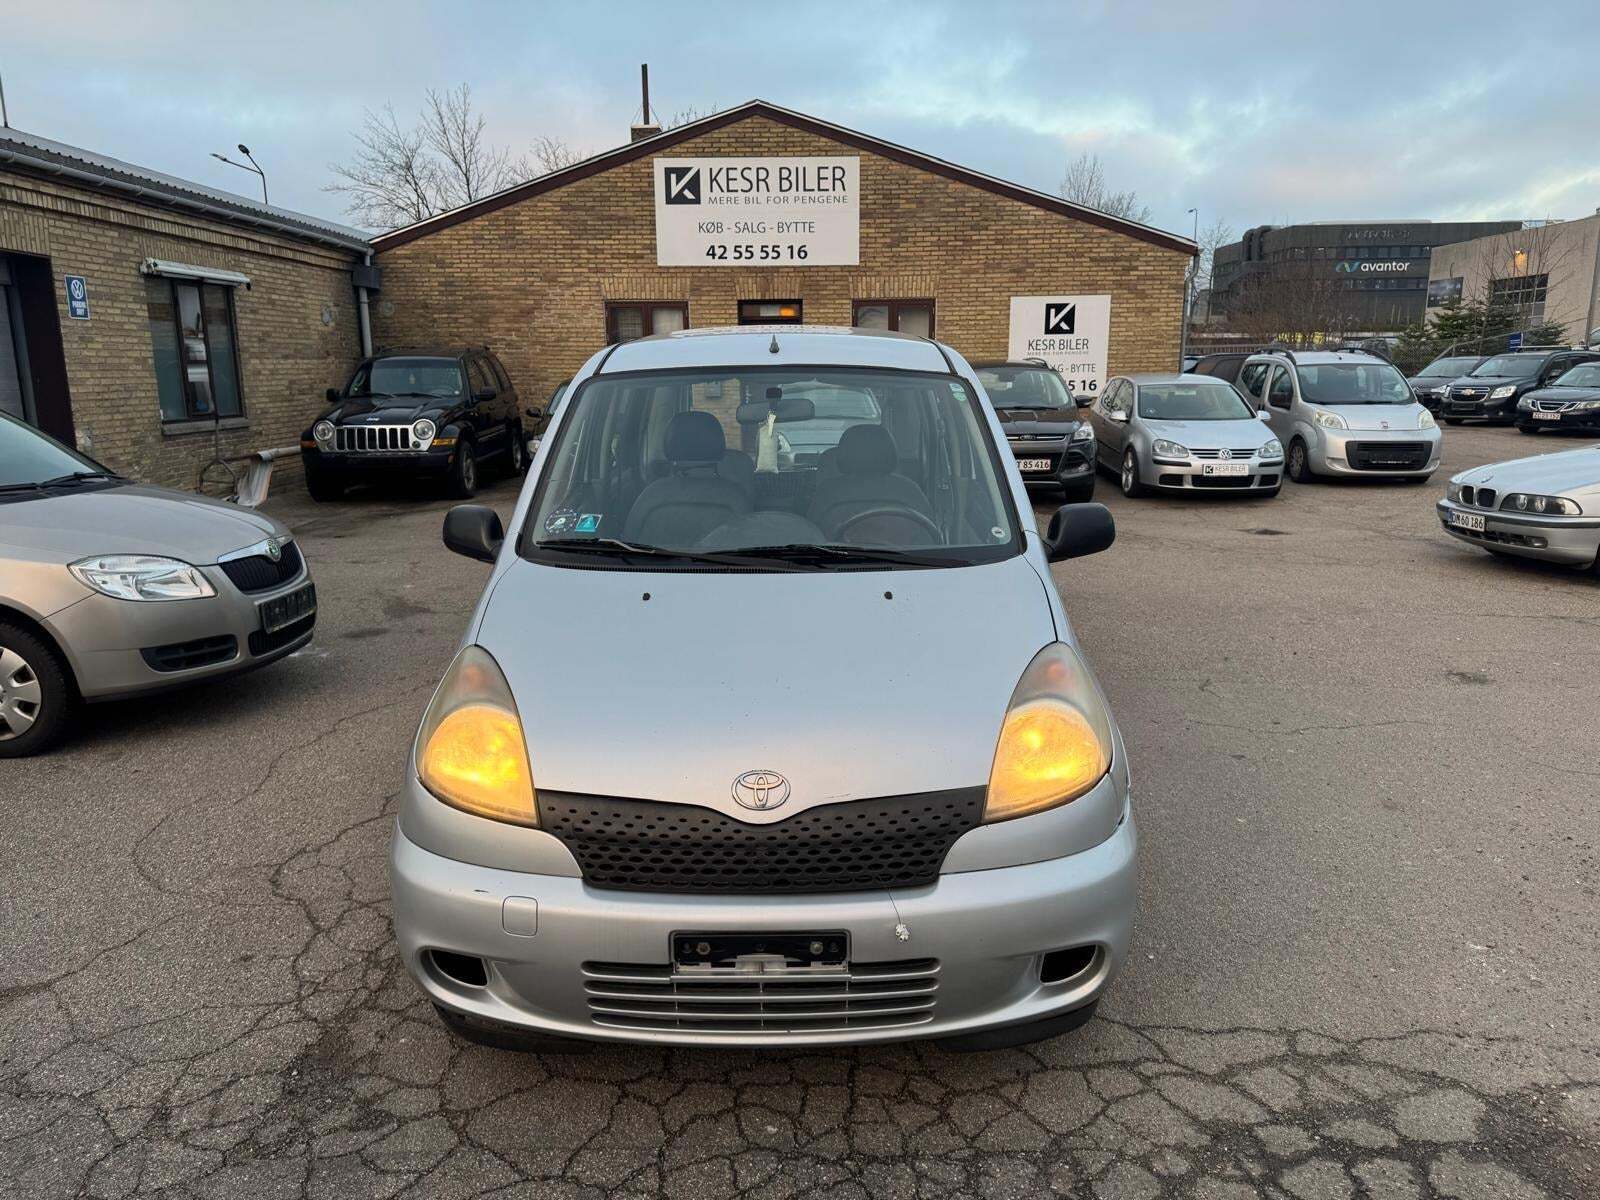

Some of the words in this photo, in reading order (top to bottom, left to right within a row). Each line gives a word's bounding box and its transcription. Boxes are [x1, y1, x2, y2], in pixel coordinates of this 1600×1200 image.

[709, 167, 770, 193] KESR
[779, 166, 846, 192] BILER
[708, 196, 739, 205] MERE
[744, 196, 762, 205] BIL
[766, 196, 790, 204] FOR
[794, 195, 848, 204] PENGENE
[698, 221, 723, 234] KØB
[734, 221, 766, 234] SALG
[777, 221, 815, 233] BYTTE
[706, 245, 728, 260] 42
[733, 245, 754, 260] 55
[760, 245, 781, 260] 55
[787, 245, 808, 260] 16
[1361, 261, 1410, 272] avantor
[1028, 339, 1056, 351] KESR
[1058, 338, 1089, 350] BILER
[1070, 363, 1097, 373] BYTTE
[1066, 380, 1075, 391] 5
[1080, 379, 1097, 391] 16
[1023, 461, 1033, 469] 85
[1034, 460, 1050, 469] 416
[1471, 516, 1483, 529] 186
